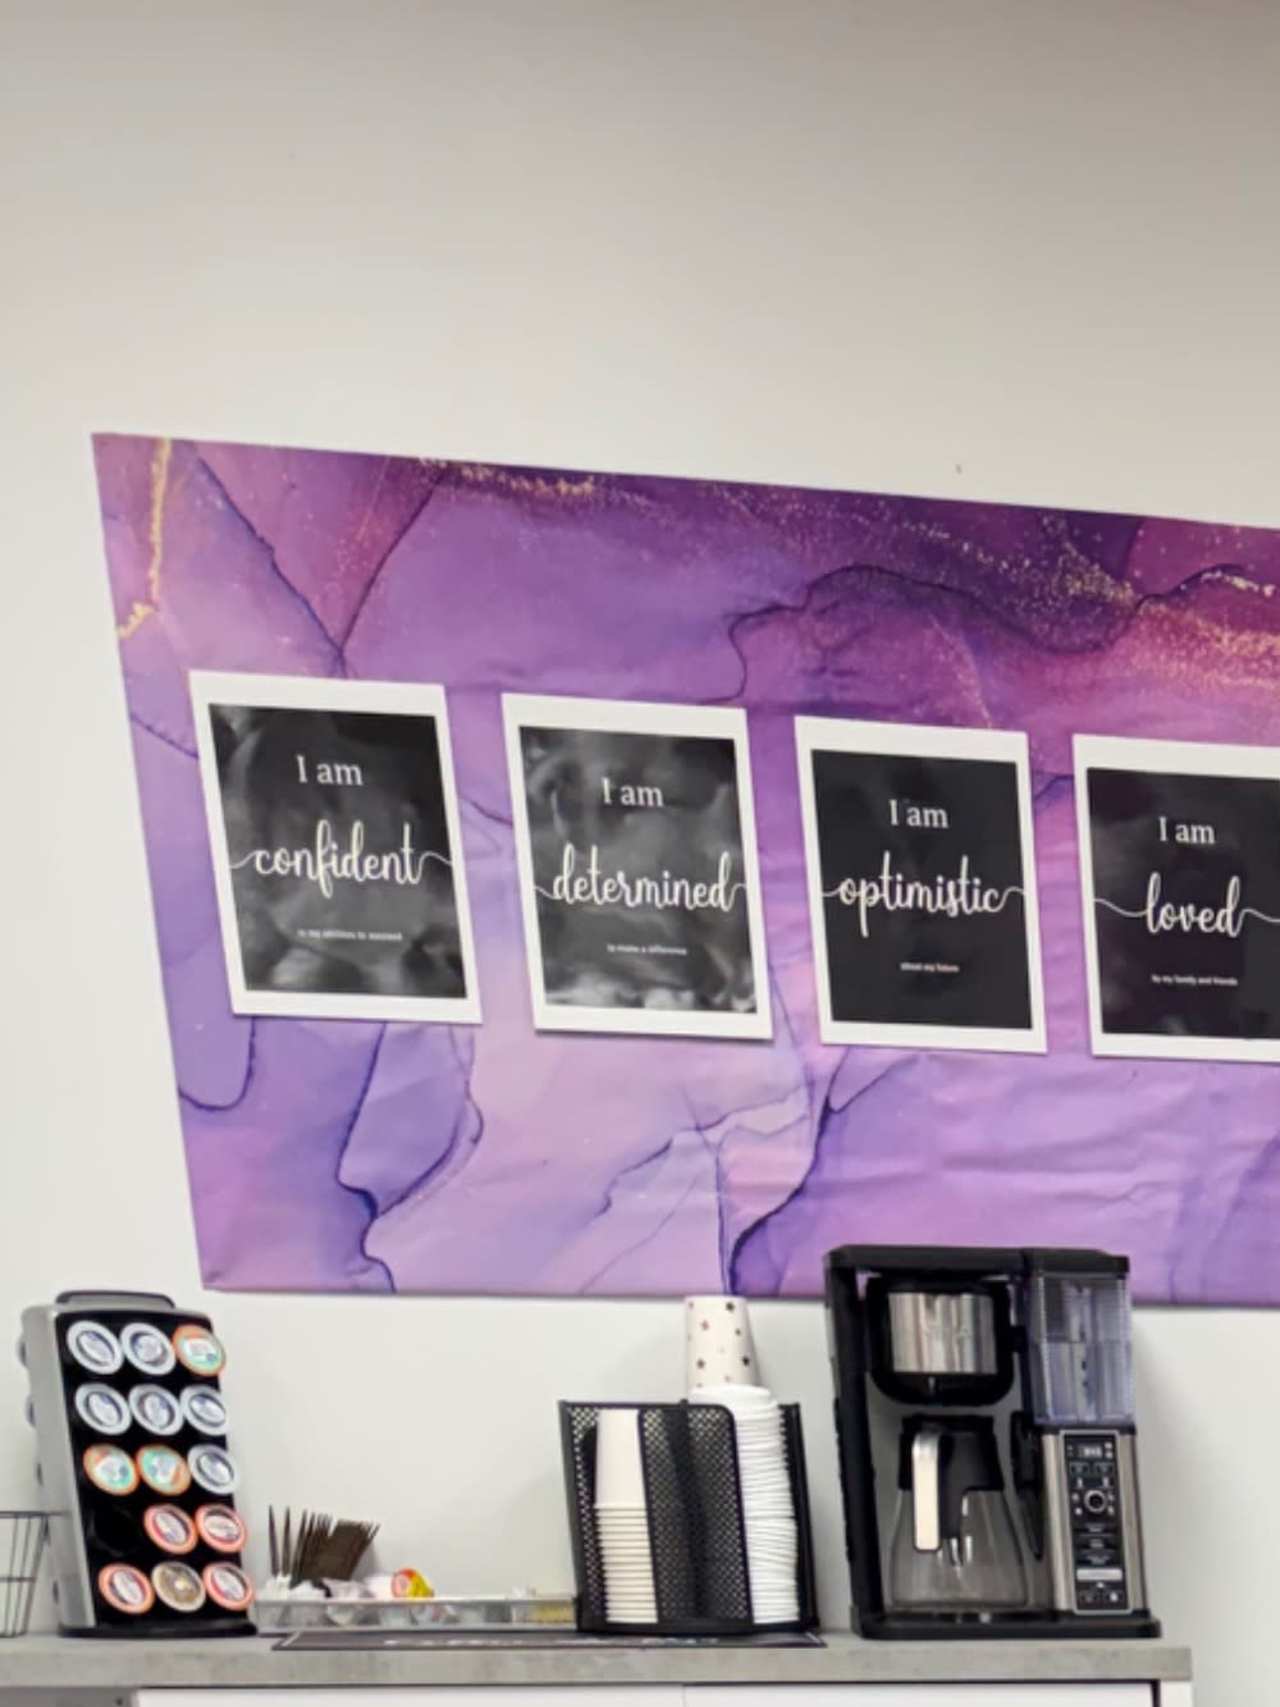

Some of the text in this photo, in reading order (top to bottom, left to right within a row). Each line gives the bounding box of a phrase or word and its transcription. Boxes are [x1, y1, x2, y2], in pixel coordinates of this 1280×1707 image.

[295, 755, 363, 786] I am
[602, 777, 664, 808] I am
[889, 800, 950, 829] I am
[1158, 816, 1215, 845] I am
[254, 818, 422, 898] confident
[552, 842, 734, 912] determined
[837, 850, 1004, 938] optimistic
[1144, 871, 1244, 938] loved
